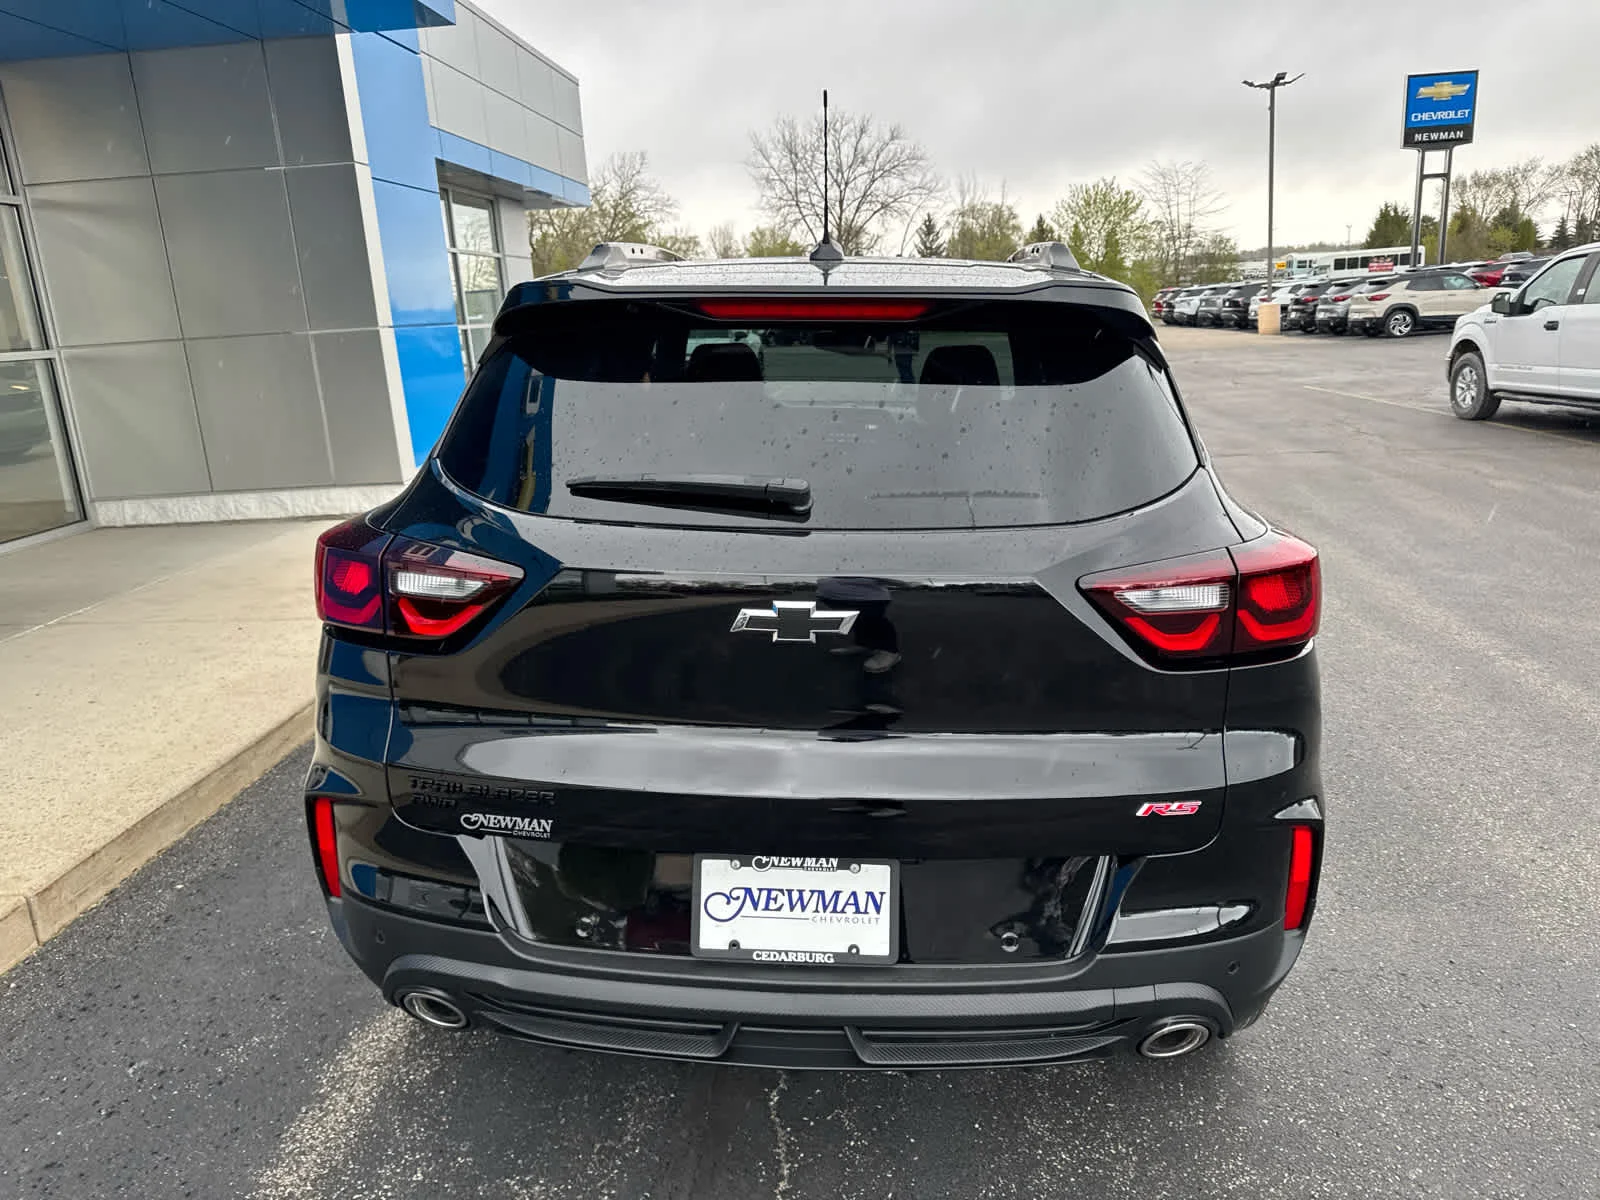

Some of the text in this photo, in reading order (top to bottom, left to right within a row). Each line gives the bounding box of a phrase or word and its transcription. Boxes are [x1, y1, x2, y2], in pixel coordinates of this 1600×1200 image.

[1411, 109, 1471, 121] CHEVROLET
[1414, 130, 1464, 141] NEWMAN
[409, 775, 555, 805] TRAILBLAZER
[1135, 801, 1202, 816] RS
[460, 813, 553, 832] NEWMAN
[512, 830, 551, 839] CHEVROLET
[752, 855, 838, 872] NEWMAN
[704, 887, 886, 922] NEWMAN
[811, 915, 880, 925] CHEVROLET
[752, 951, 835, 963] CEDARBURG
